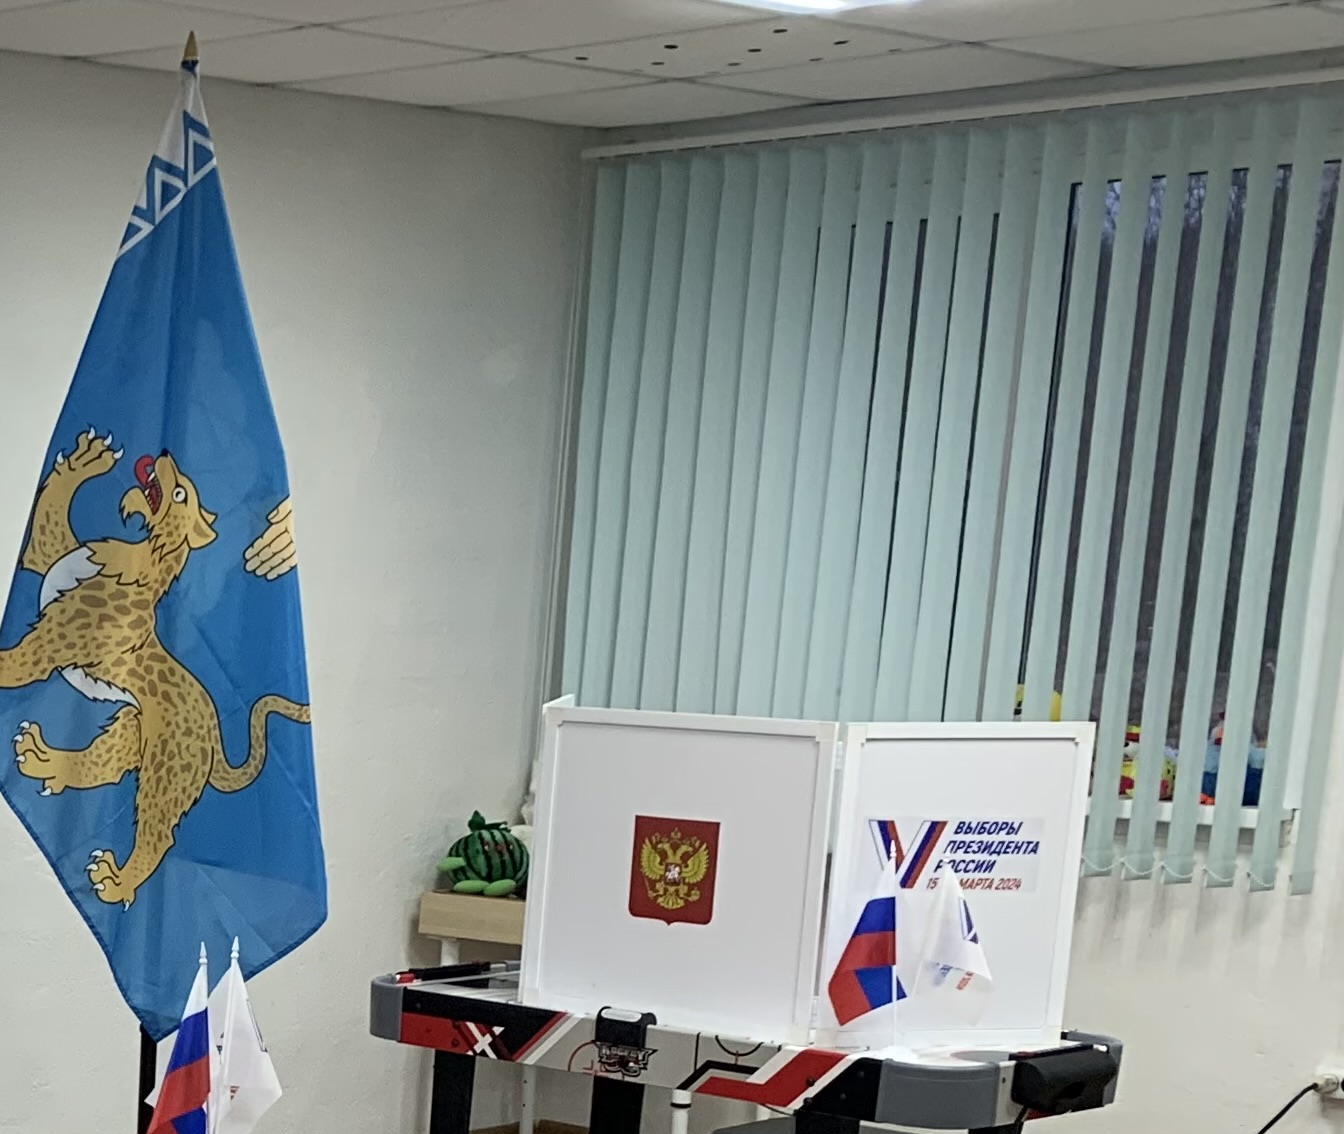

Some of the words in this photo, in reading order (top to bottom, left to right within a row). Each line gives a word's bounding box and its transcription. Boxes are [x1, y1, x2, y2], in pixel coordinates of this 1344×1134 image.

[953, 821, 1023, 836] ВЫБОРЫ
[943, 840, 1040, 856] ПРЕЗИДЕНТА
[959, 878, 996, 890] МАРТА
[994, 878, 1023, 890] 2024
